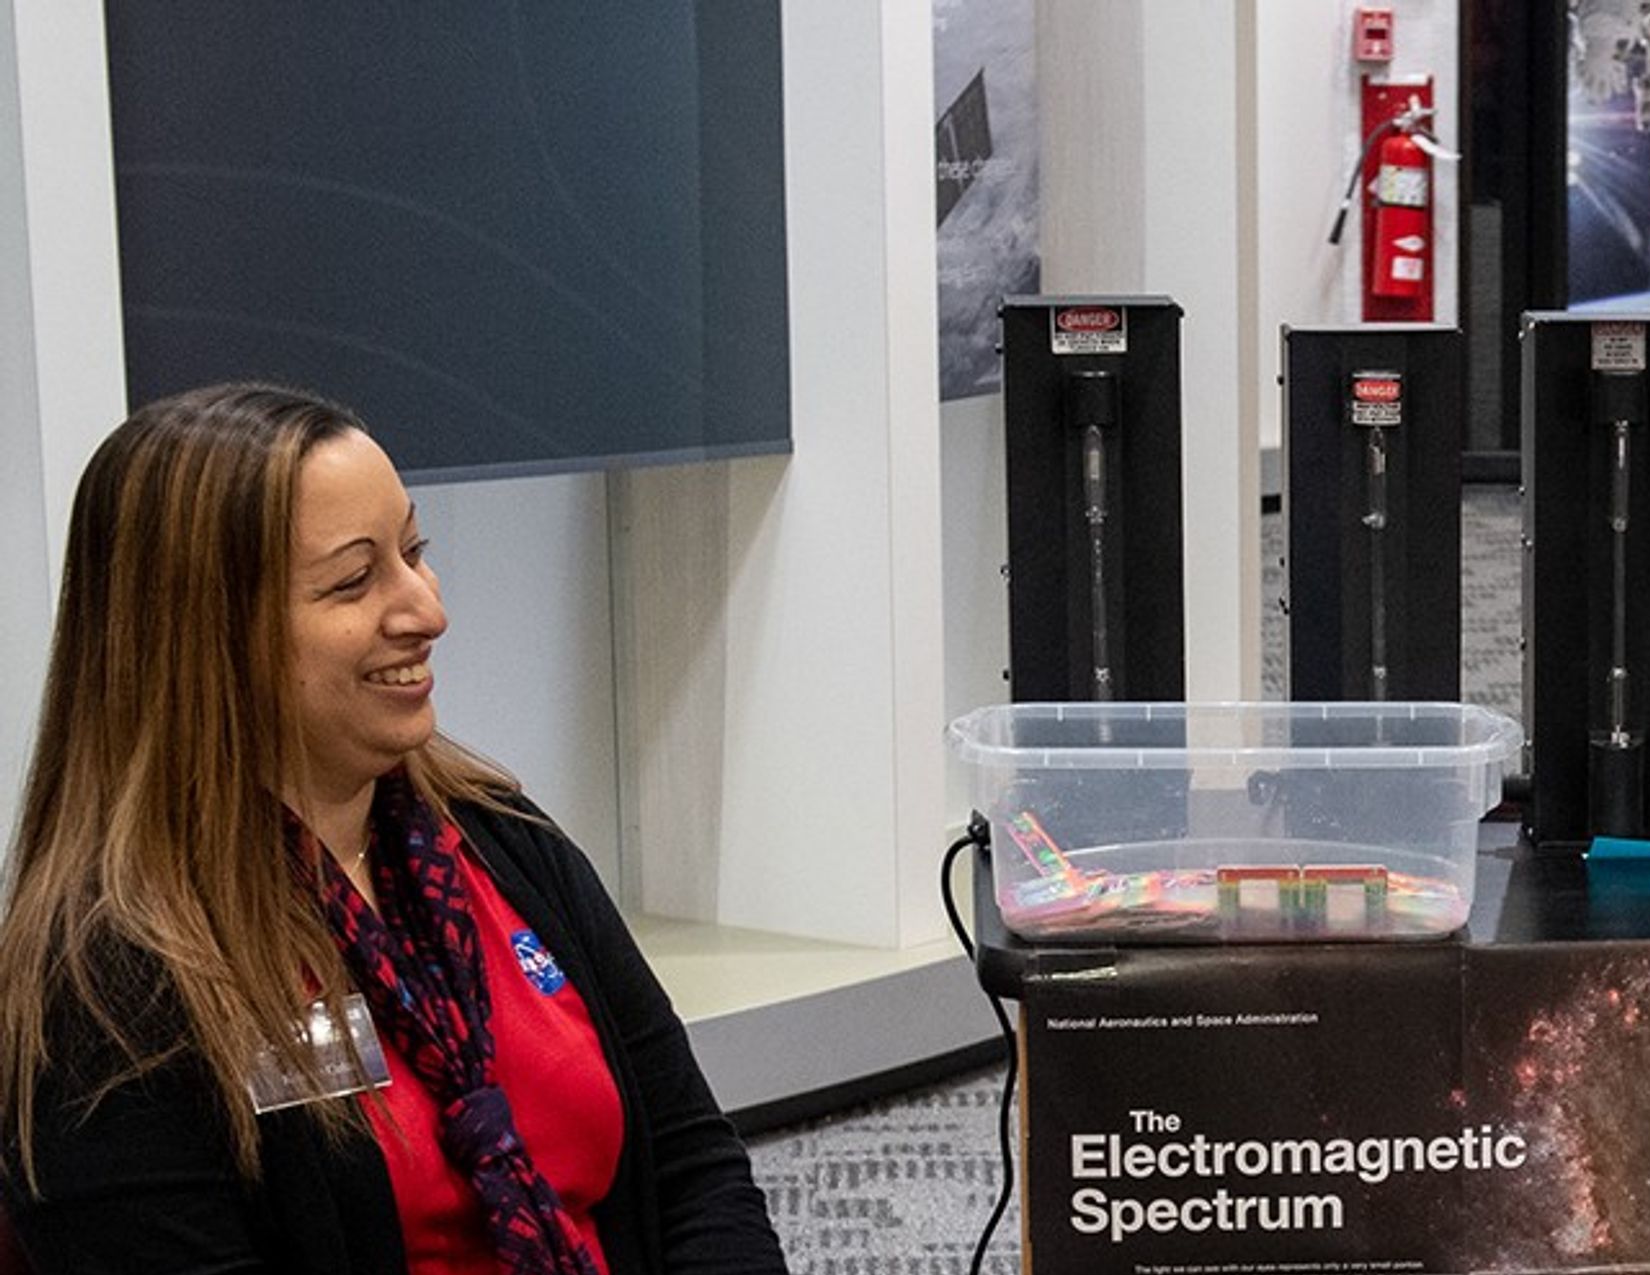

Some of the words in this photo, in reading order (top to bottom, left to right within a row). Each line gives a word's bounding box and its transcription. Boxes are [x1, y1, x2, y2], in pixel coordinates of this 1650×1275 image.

[1047, 1017, 1096, 1028] National
[1098, 1016, 1167, 1027] Aeronautics
[1171, 1015, 1192, 1025] and
[1196, 1014, 1232, 1027] Space
[1235, 1012, 1318, 1024] Administration
[1129, 1110, 1181, 1133] The
[1070, 1126, 1527, 1183] Electromagnetic
[1070, 1187, 1344, 1242] Spectrum
